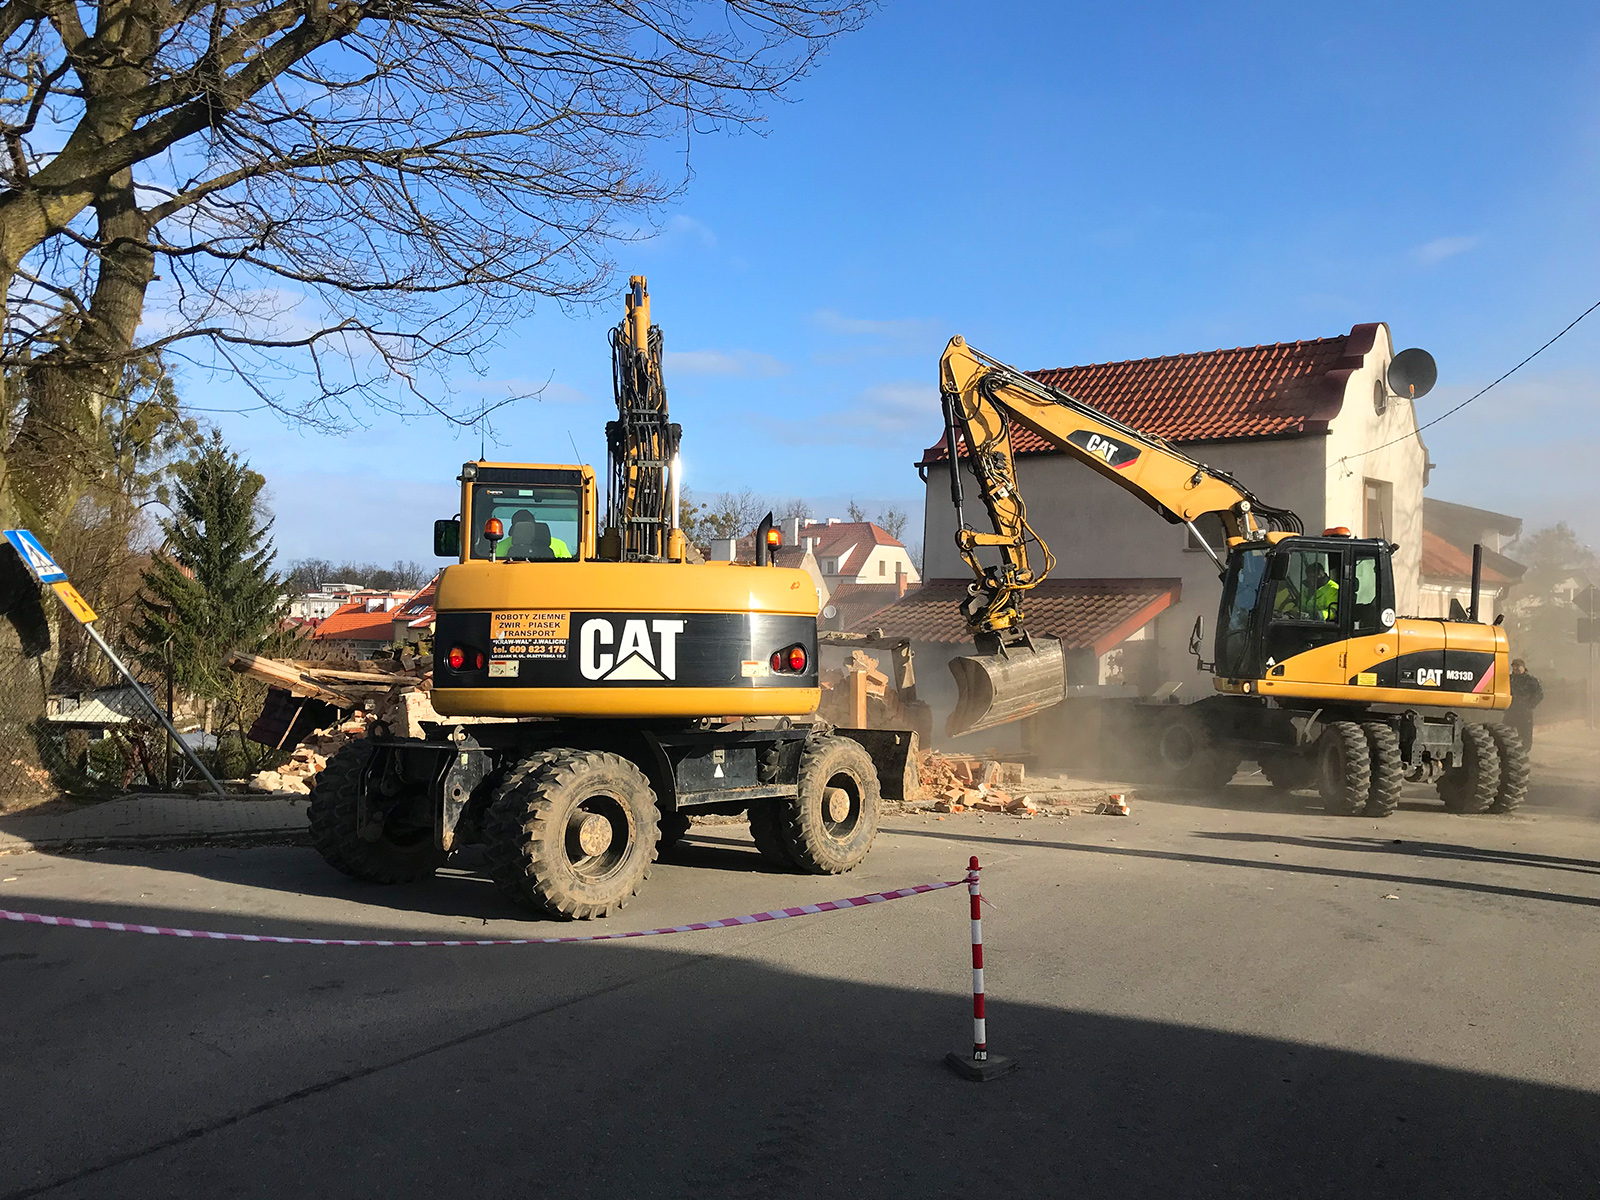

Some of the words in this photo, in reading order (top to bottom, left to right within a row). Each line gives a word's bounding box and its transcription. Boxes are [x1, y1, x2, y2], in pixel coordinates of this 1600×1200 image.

[1086, 434, 1119, 463] CAT
[495, 613, 530, 621] ROBOTY
[1384, 612, 1393, 623] 20
[528, 621, 561, 629] PIASEK
[493, 645, 507, 654] tel.
[509, 645, 527, 654] 609
[528, 645, 545, 654] 823
[548, 645, 566, 654] 175
[580, 618, 684, 681] CAT
[1417, 667, 1444, 687] CAT
[1446, 669, 1474, 681] M313D
